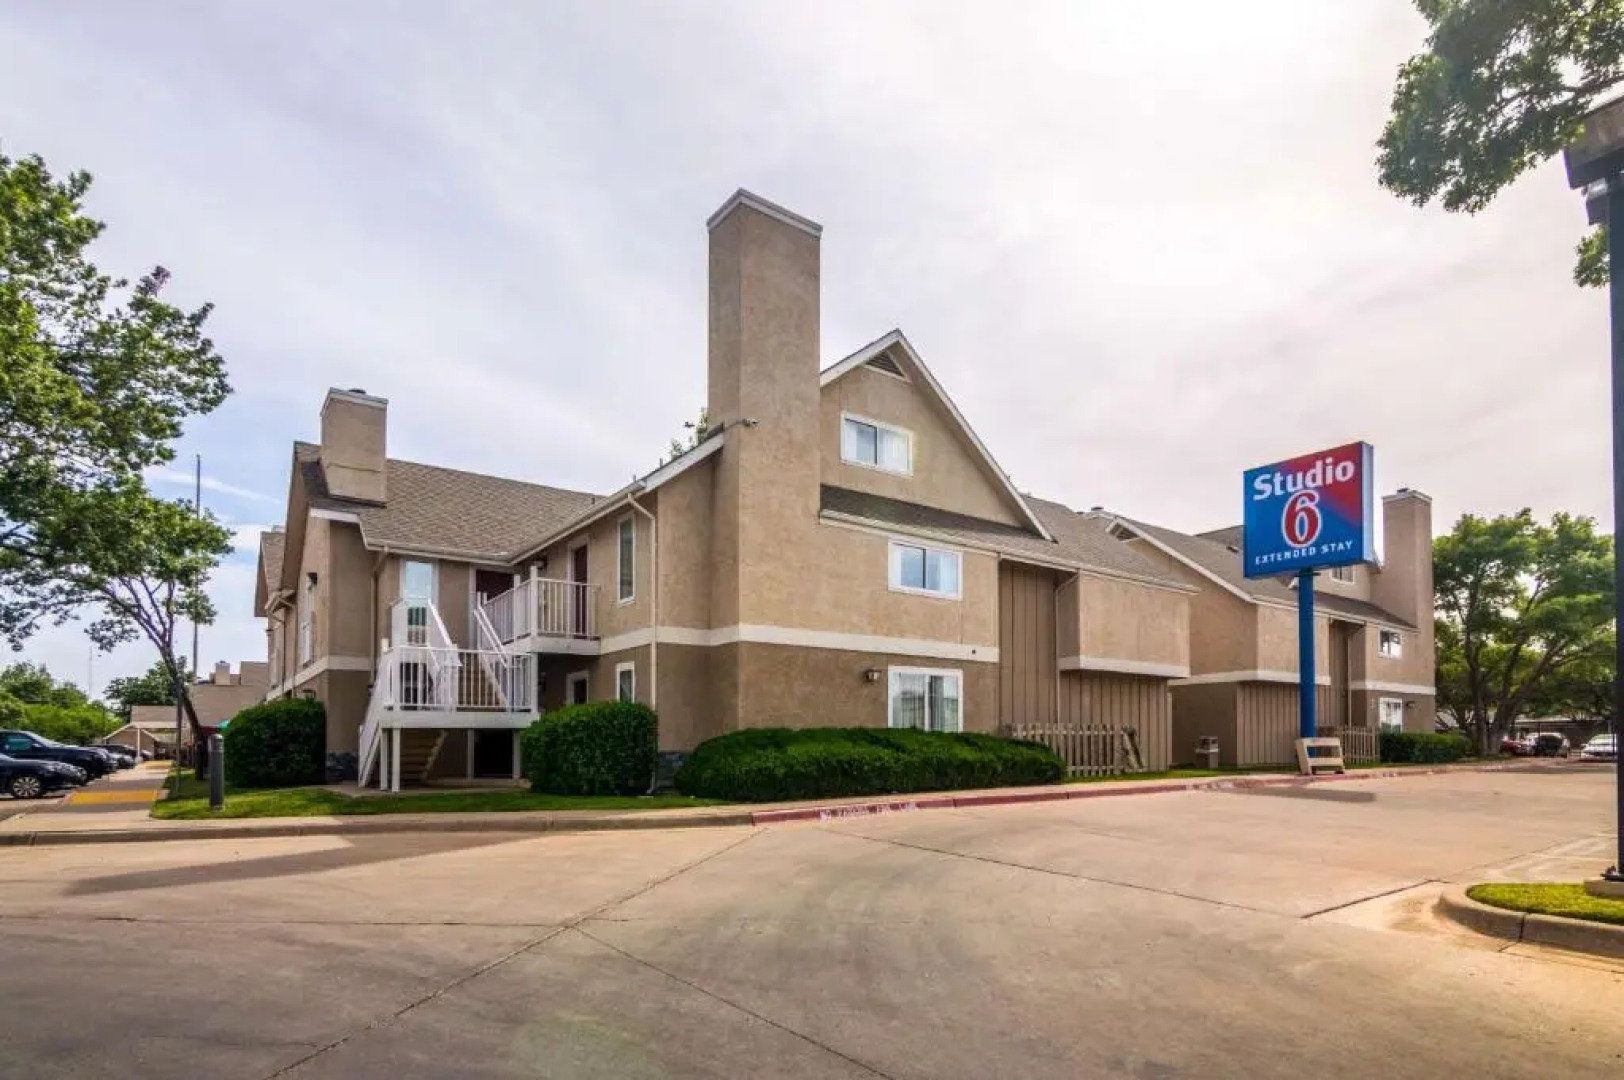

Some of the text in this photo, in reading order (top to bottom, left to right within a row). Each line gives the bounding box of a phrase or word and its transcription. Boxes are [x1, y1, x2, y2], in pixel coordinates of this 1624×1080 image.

[1253, 457, 1355, 501] Studio
[1282, 489, 1322, 548] 6
[1255, 540, 1353, 565] EXTENDED STAY
